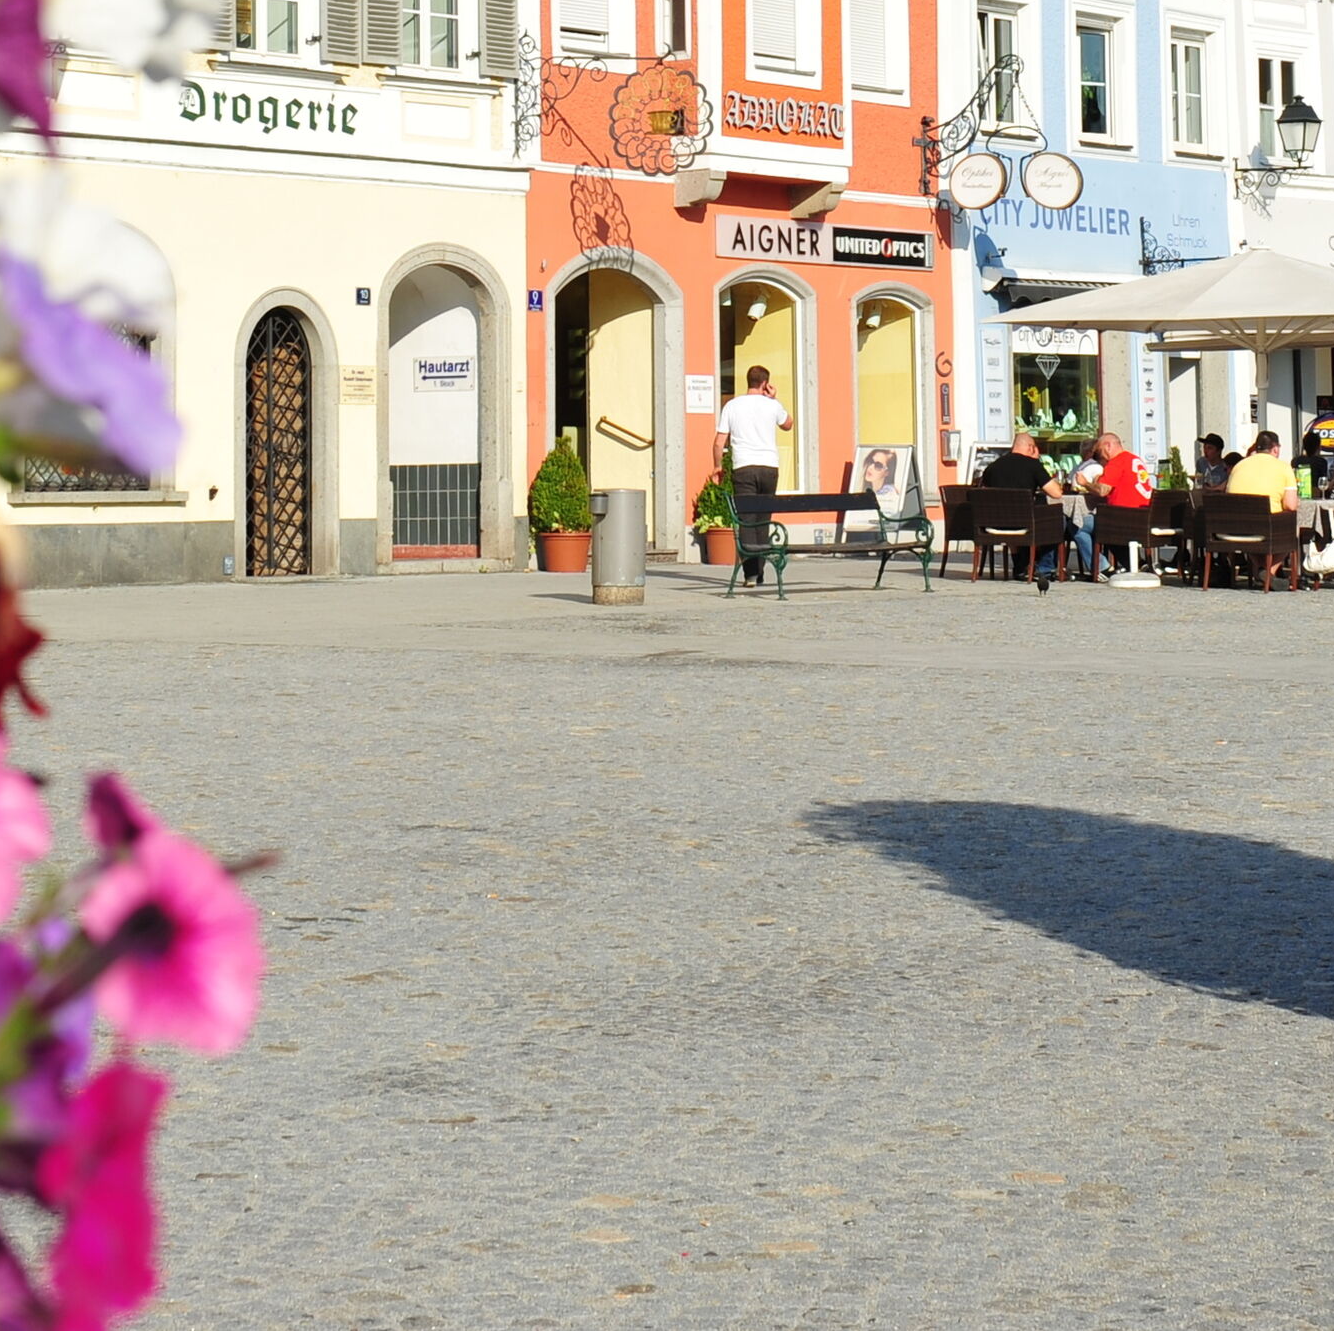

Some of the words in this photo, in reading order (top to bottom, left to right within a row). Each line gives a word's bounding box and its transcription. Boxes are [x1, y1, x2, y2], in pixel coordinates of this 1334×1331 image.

[179, 79, 359, 136] Drogerie
[724, 89, 846, 140] ADVOKAT
[1029, 201, 1130, 236] JUWELIER
[1172, 214, 1200, 228] Uhren
[732, 221, 821, 257] AIGNER
[1166, 233, 1208, 249] Schmuck
[532, 291, 539, 304] 9
[418, 359, 470, 374] Hautarzt
